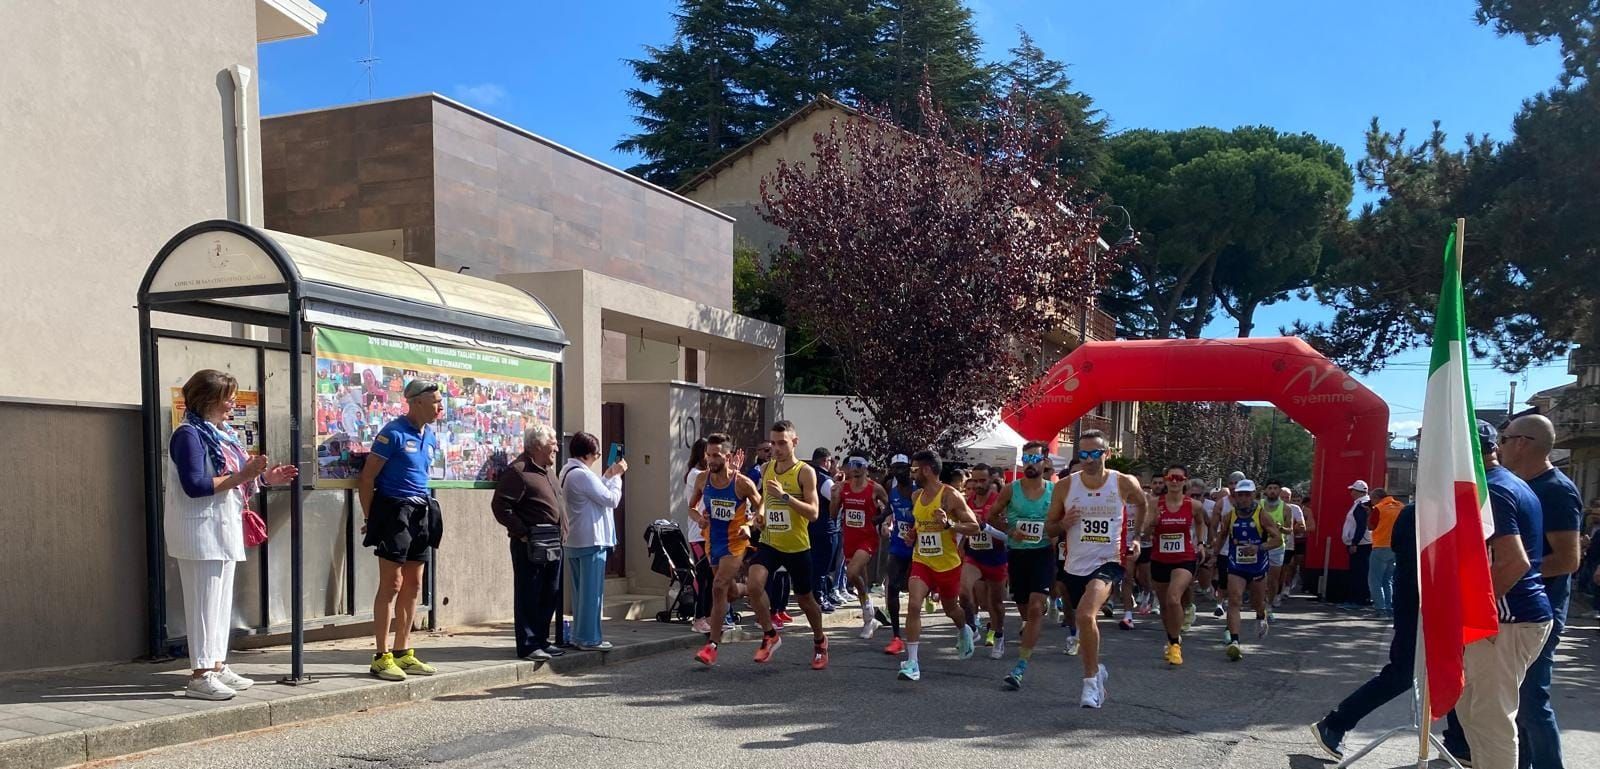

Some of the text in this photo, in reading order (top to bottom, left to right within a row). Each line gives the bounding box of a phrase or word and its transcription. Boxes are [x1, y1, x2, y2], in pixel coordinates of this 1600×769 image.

[1291, 392, 1354, 406] syemme
[677, 415, 696, 449] 10
[715, 507, 731, 519] 404
[769, 511, 785, 522] 481
[848, 511, 861, 520] 466
[1020, 523, 1040, 534] 416
[1083, 519, 1109, 534] 399
[920, 535, 936, 546] 441
[1163, 541, 1181, 551] 470
